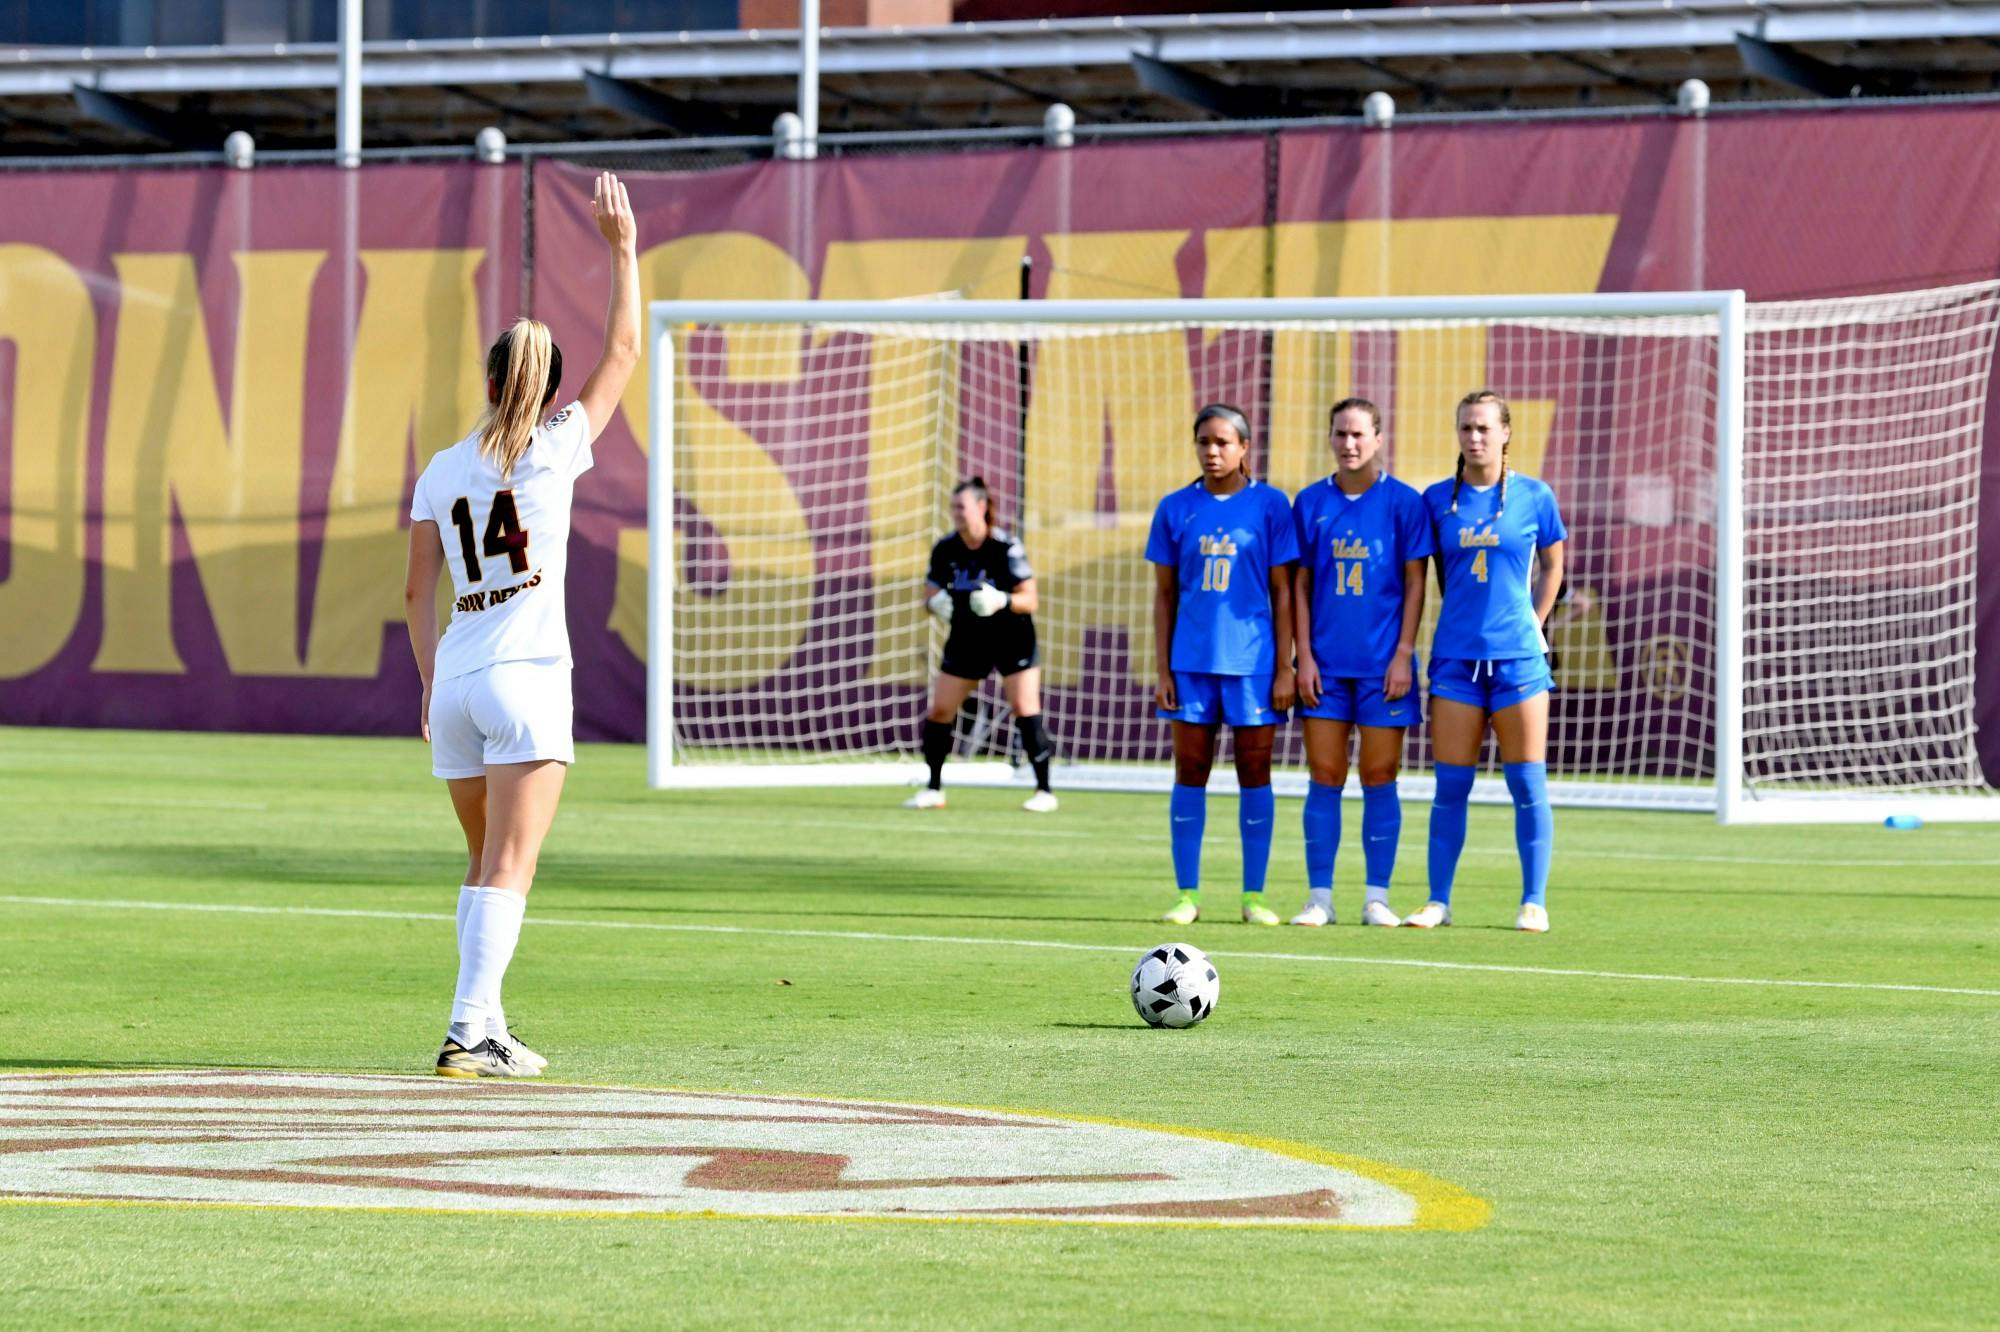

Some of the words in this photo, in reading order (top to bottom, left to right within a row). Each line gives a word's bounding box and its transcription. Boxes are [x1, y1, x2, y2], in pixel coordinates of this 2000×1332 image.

[451, 487, 530, 584] 14
[1201, 557, 1231, 592] 10
[1335, 562, 1364, 596] 14
[1470, 549, 1488, 583] 4
[490, 567, 542, 607] DES
